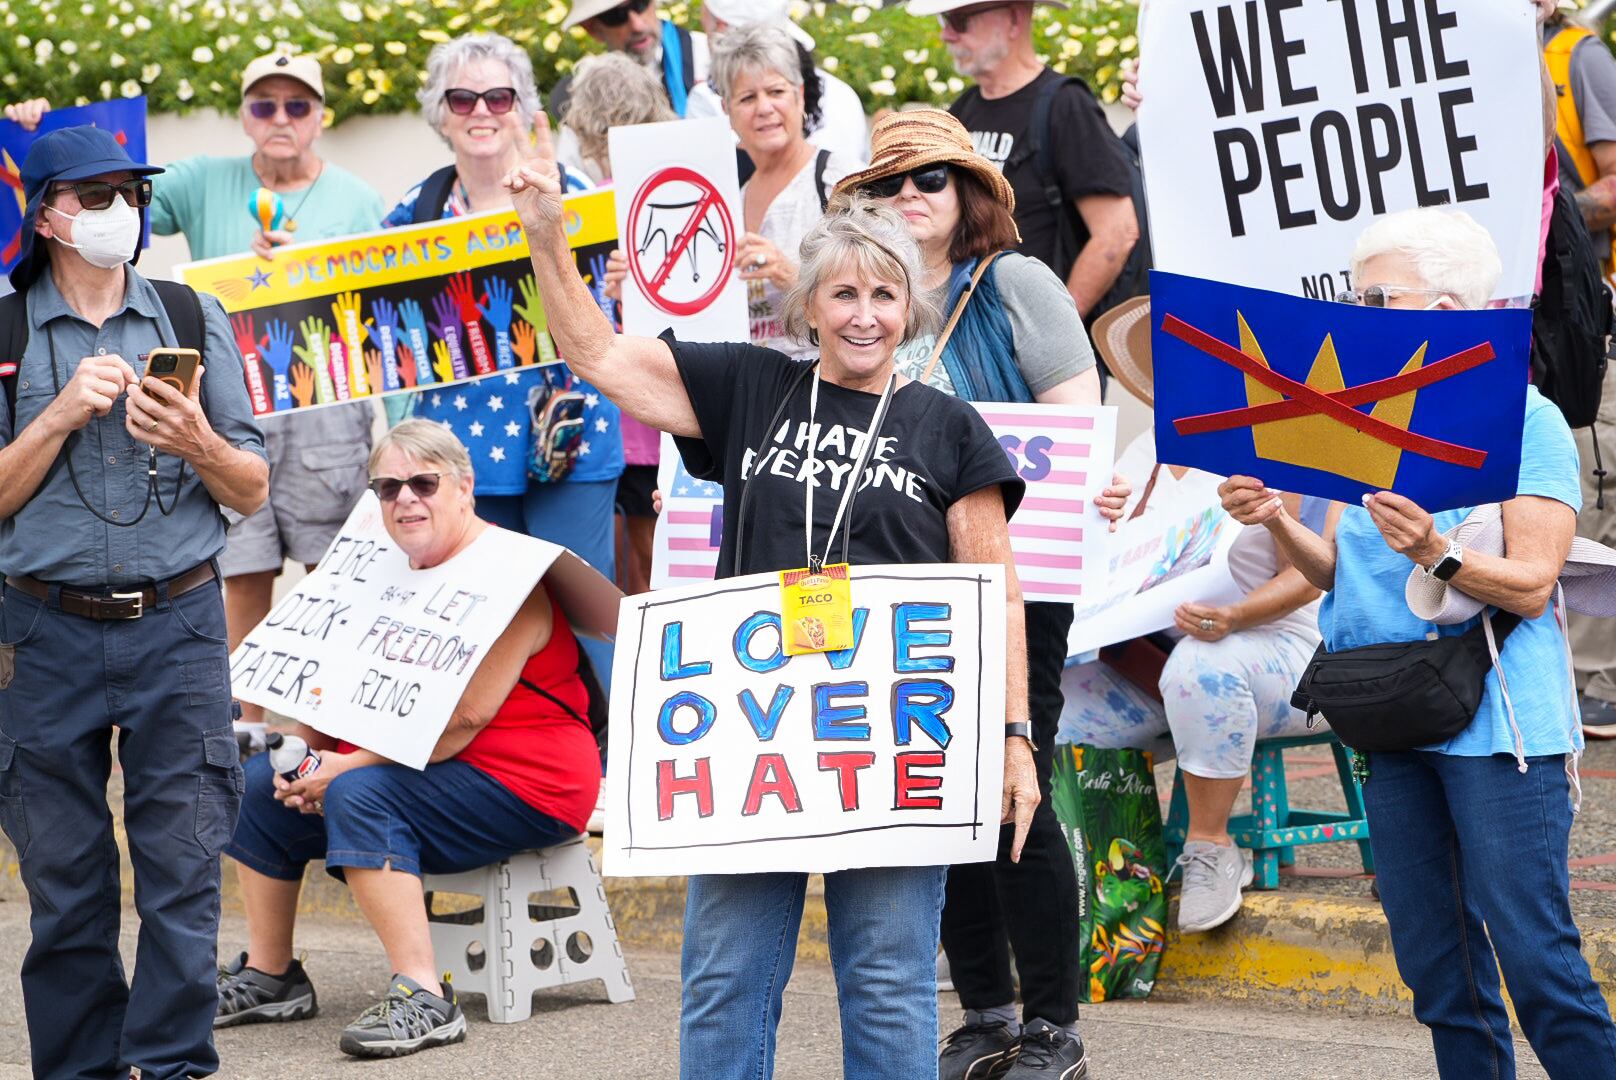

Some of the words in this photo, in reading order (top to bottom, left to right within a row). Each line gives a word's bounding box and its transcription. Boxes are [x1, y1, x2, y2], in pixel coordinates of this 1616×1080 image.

[1190, 0, 1319, 118] WE
[1327, 0, 1470, 94] THE
[1213, 87, 1489, 237] PEOPLE
[285, 235, 452, 287] DEMOCRATS
[444, 326, 467, 379] EQUALITY
[466, 320, 492, 375] FREEDOM
[496, 331, 512, 370] PEACE
[245, 353, 268, 412] LIBERTAD
[274, 374, 289, 400] PAZ
[773, 418, 791, 444] I
[794, 421, 899, 463] HATE
[319, 536, 388, 583] FIRE
[423, 582, 488, 627] LET
[799, 593, 833, 605] TACO
[356, 615, 479, 676] FREEDOM
[660, 602, 955, 682] LOVE
[351, 668, 422, 718] RING
[656, 678, 955, 750] OVER
[655, 750, 946, 822] HATE
[1076, 769, 1113, 790] Costa
[1116, 771, 1155, 795] Rica
